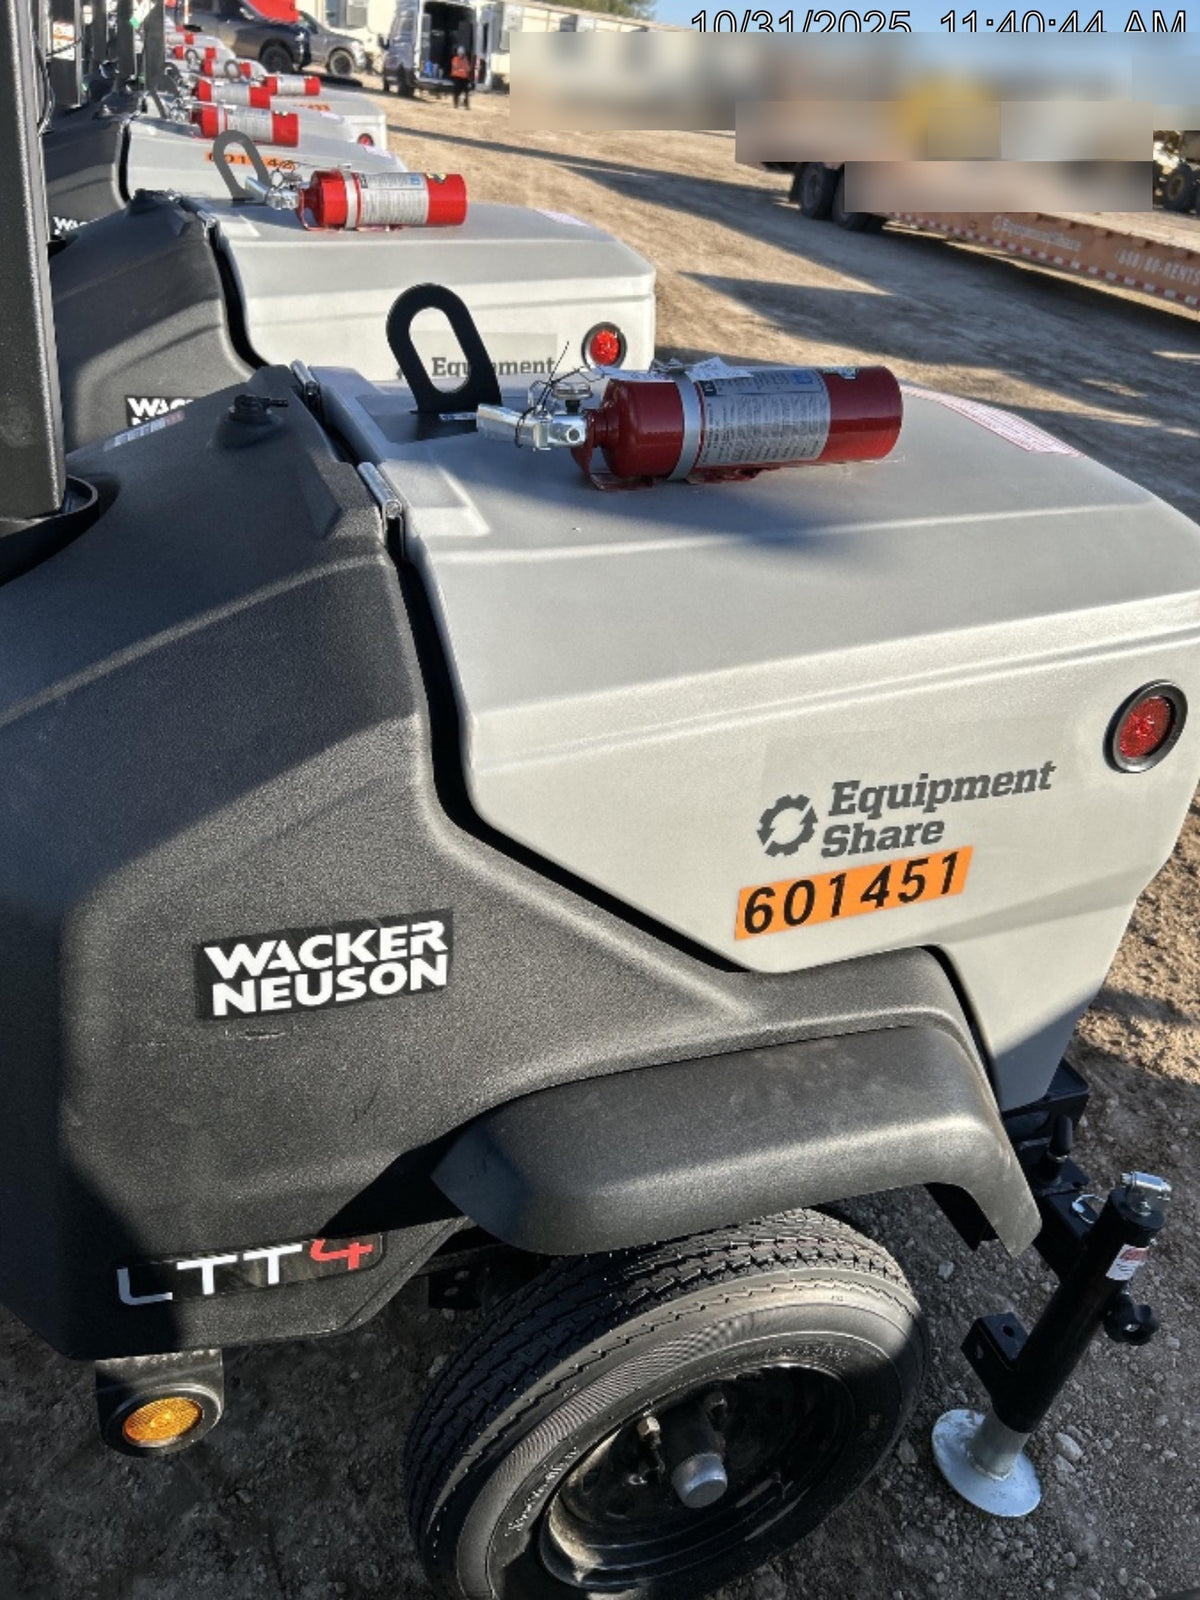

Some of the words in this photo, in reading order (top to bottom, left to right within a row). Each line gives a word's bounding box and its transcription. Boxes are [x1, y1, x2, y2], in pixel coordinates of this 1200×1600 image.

[431, 357, 556, 377] Equment
[828, 760, 1057, 820] Equipment
[820, 820, 945, 858] Share
[743, 851, 960, 935] 601451
[204, 920, 449, 980] WACKER
[212, 954, 448, 1017] NEUSON
